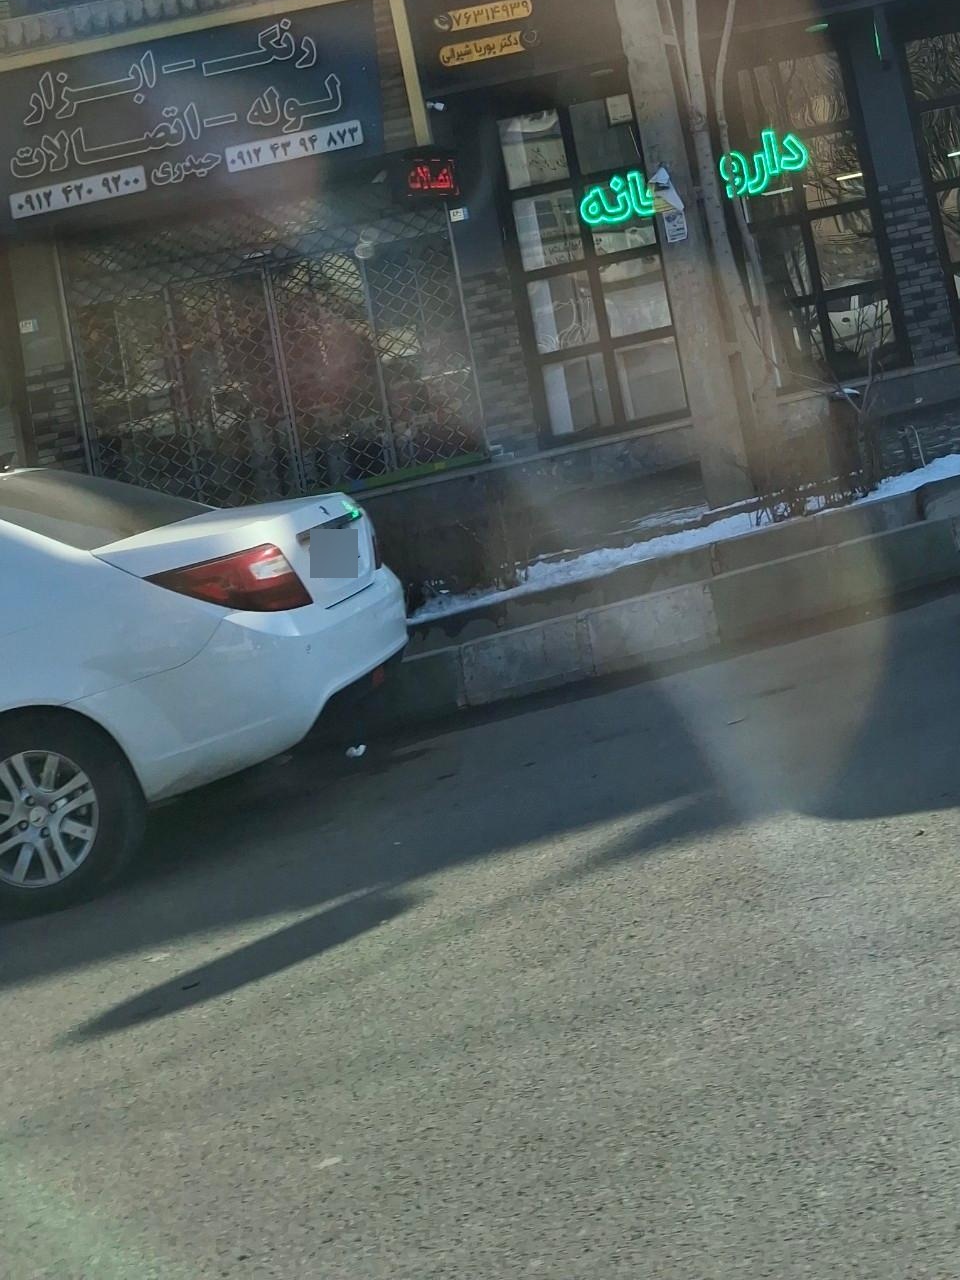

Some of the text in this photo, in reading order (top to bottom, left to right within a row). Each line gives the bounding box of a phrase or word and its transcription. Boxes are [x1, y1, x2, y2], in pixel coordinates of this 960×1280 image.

[452, 0, 530, 27] ۷۶۳۱۴۹۳۹
[202, 19, 317, 77] رنگ
[24, 50, 157, 125] ابزار
[247, 74, 341, 133] لوله
[10, 102, 201, 178] اتصالات
[230, 125, 360, 167] ۰۹۱۲ ۴۳ ۹۴ ۸۷۳
[151, 151, 222, 186] حیدری
[17, 189, 53, 211] ۰۹۱۲
[579, 170, 657, 224] انه
